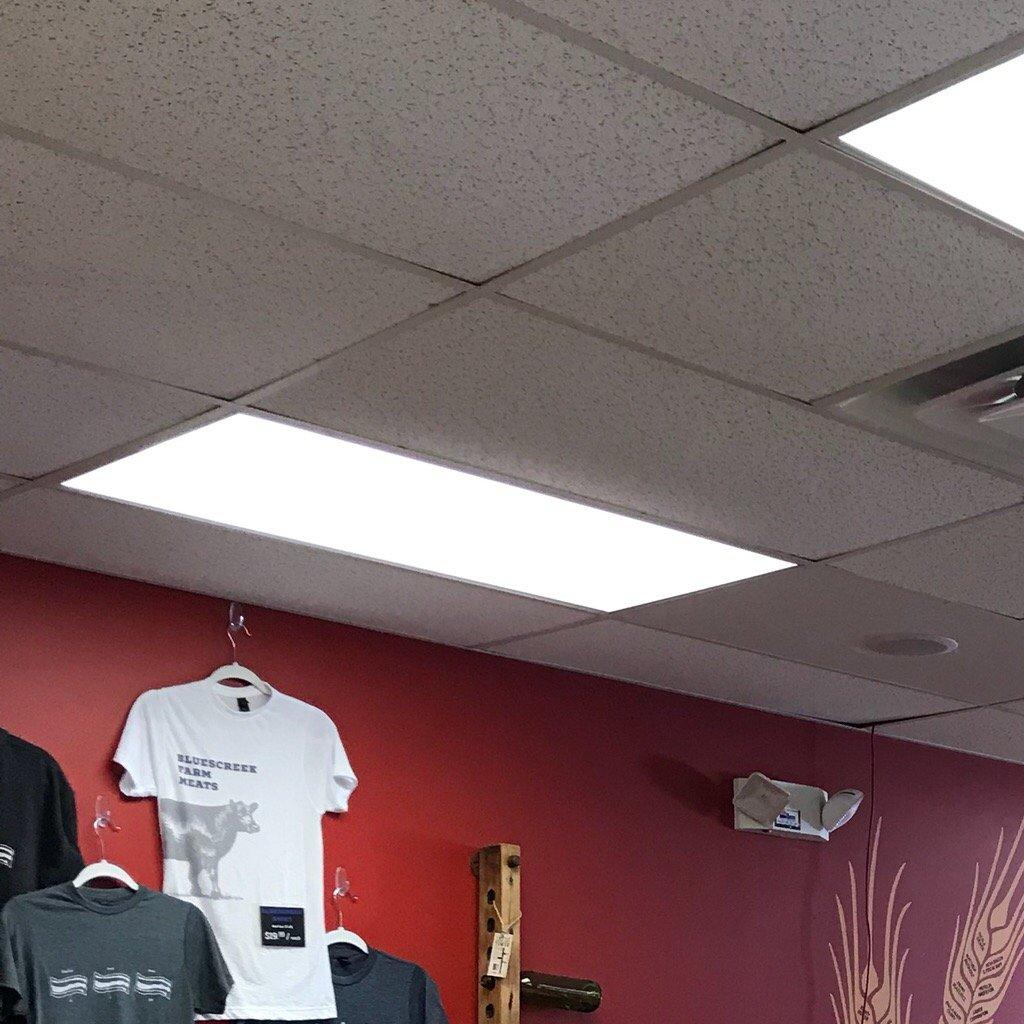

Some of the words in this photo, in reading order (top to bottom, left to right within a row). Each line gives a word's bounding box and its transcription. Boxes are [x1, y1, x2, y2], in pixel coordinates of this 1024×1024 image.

[177, 753, 258, 774] BLUESCREEK
[178, 764, 212, 778] FARM
[179, 776, 219, 791] MEATS
